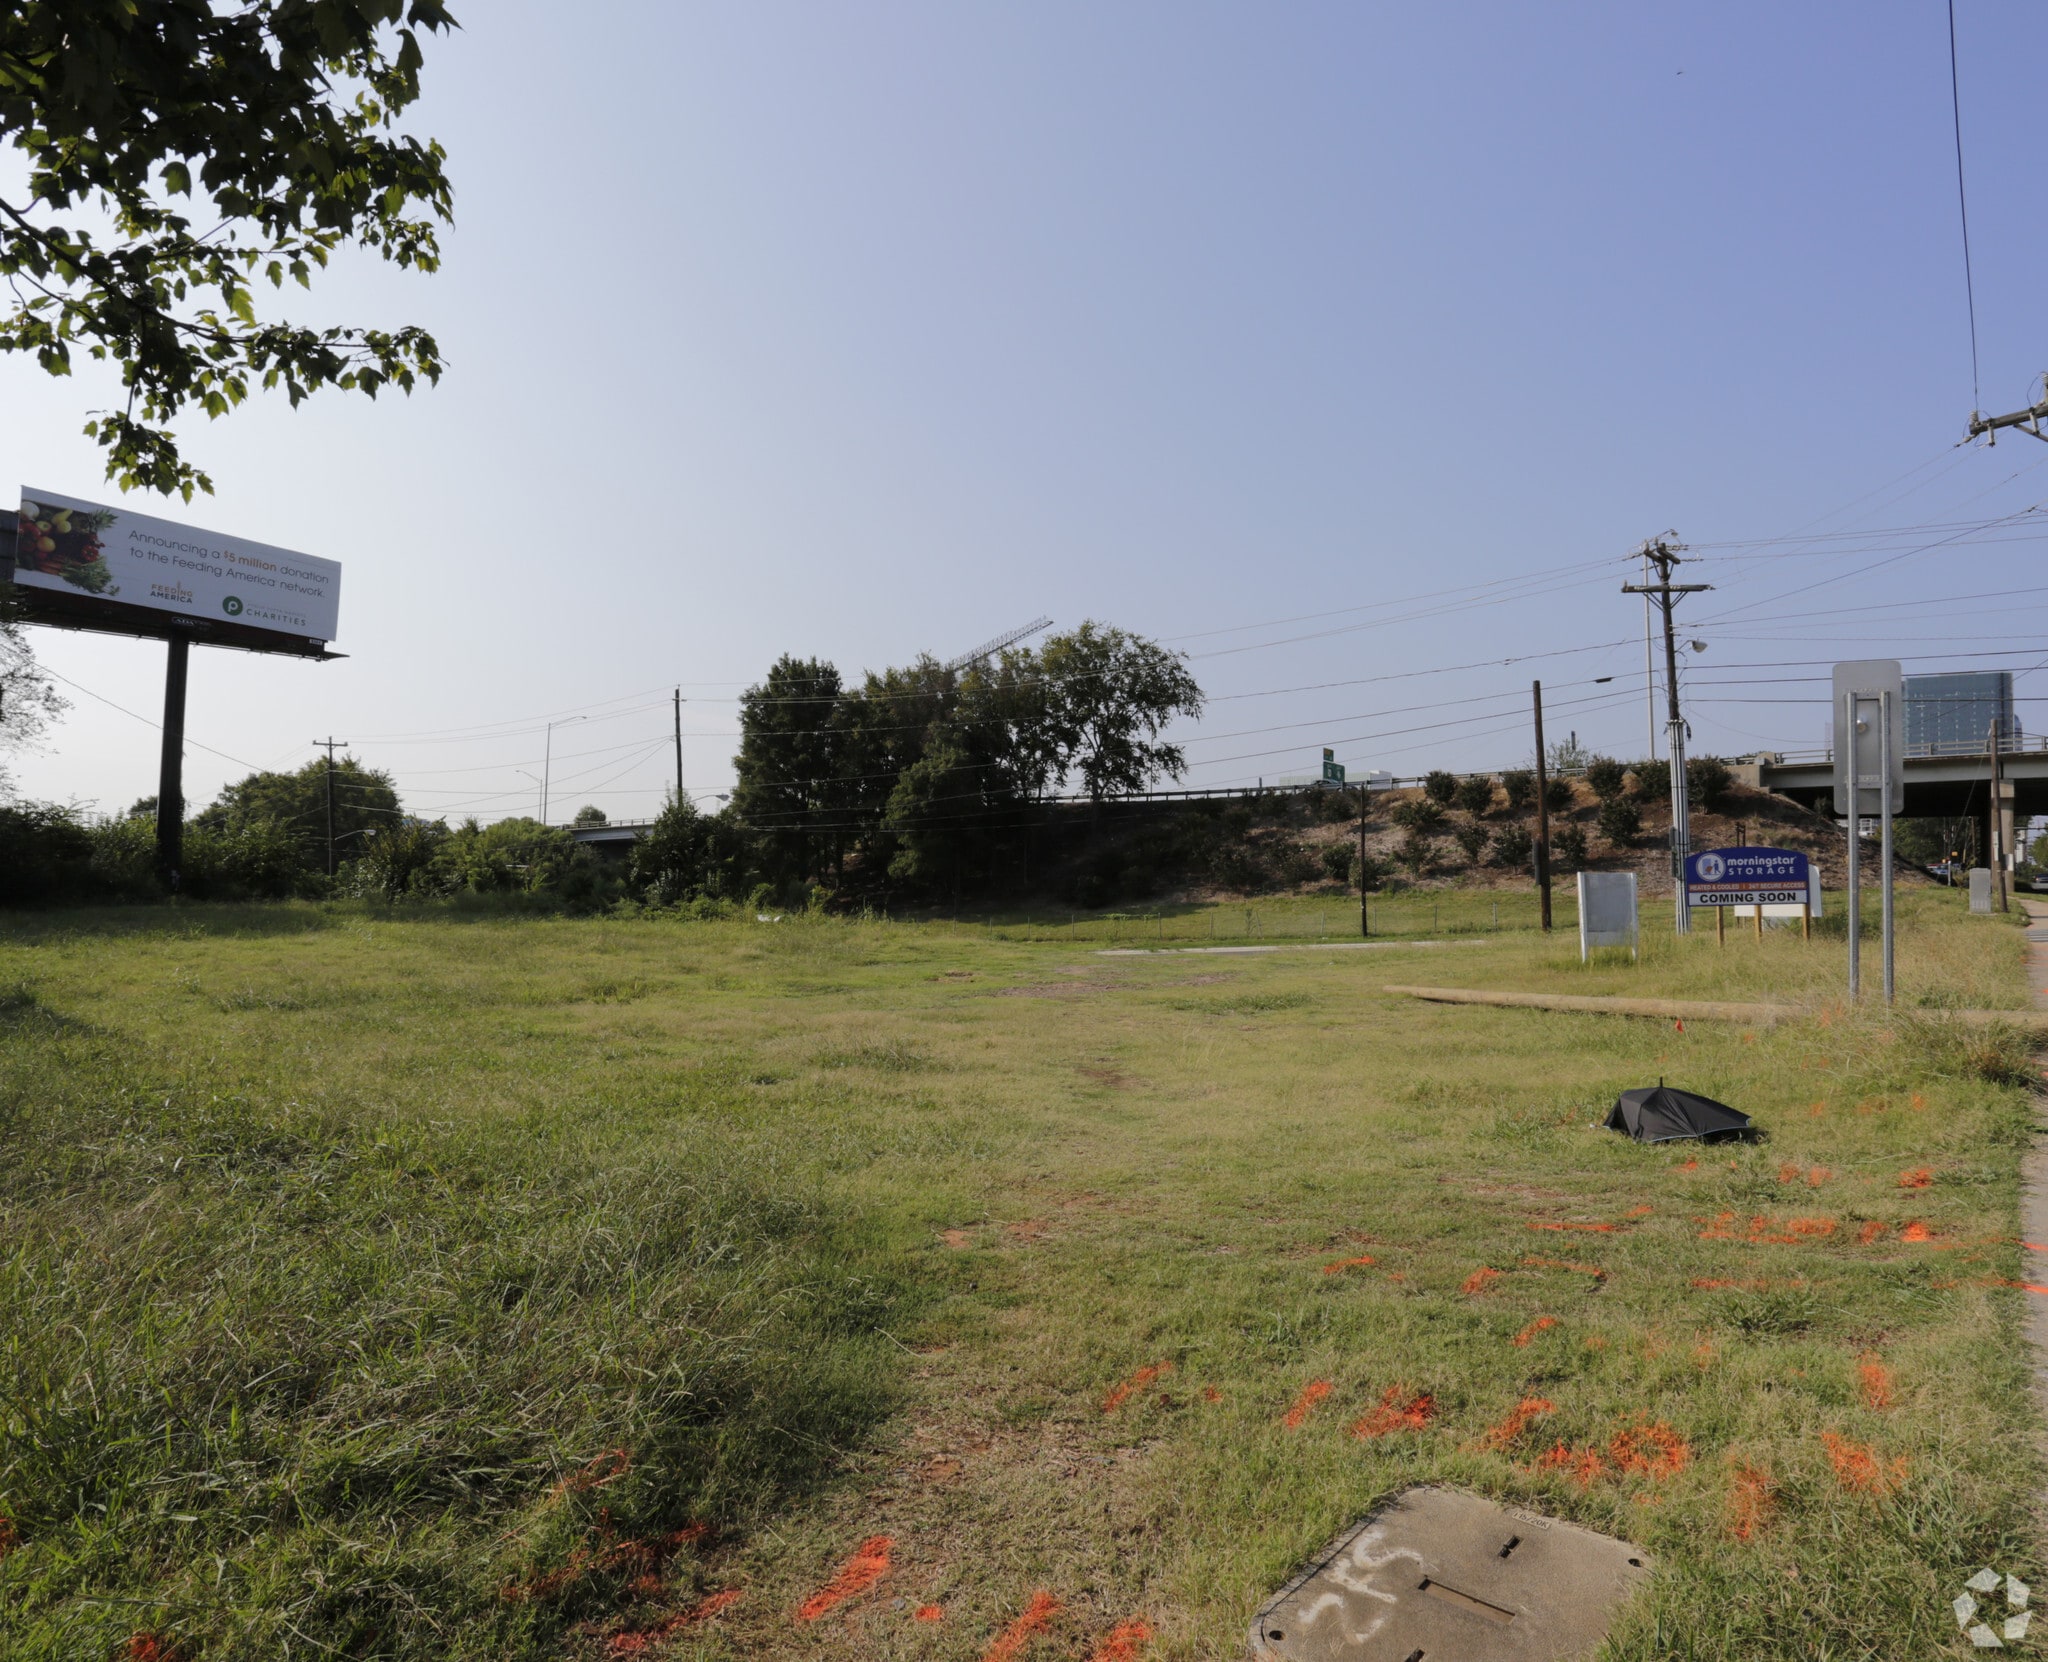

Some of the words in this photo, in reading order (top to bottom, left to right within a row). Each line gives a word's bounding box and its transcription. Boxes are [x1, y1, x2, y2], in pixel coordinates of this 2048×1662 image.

[129, 530, 208, 558] Announcing
[211, 550, 220, 559] a
[223, 550, 235, 562] $5
[239, 557, 277, 572] million
[280, 566, 329, 584] donation
[130, 547, 144, 559] to
[147, 550, 169, 564] the
[173, 556, 222, 577] Feeding
[226, 568, 276, 587] America
[150, 590, 193, 603] AMERICA
[246, 608, 307, 627] CHARITIES
[1727, 856, 1795, 868] morningstar
[1728, 866, 1795, 876] STORAGE
[1700, 892, 1754, 904] COMING
[1758, 892, 1797, 902] SOON
